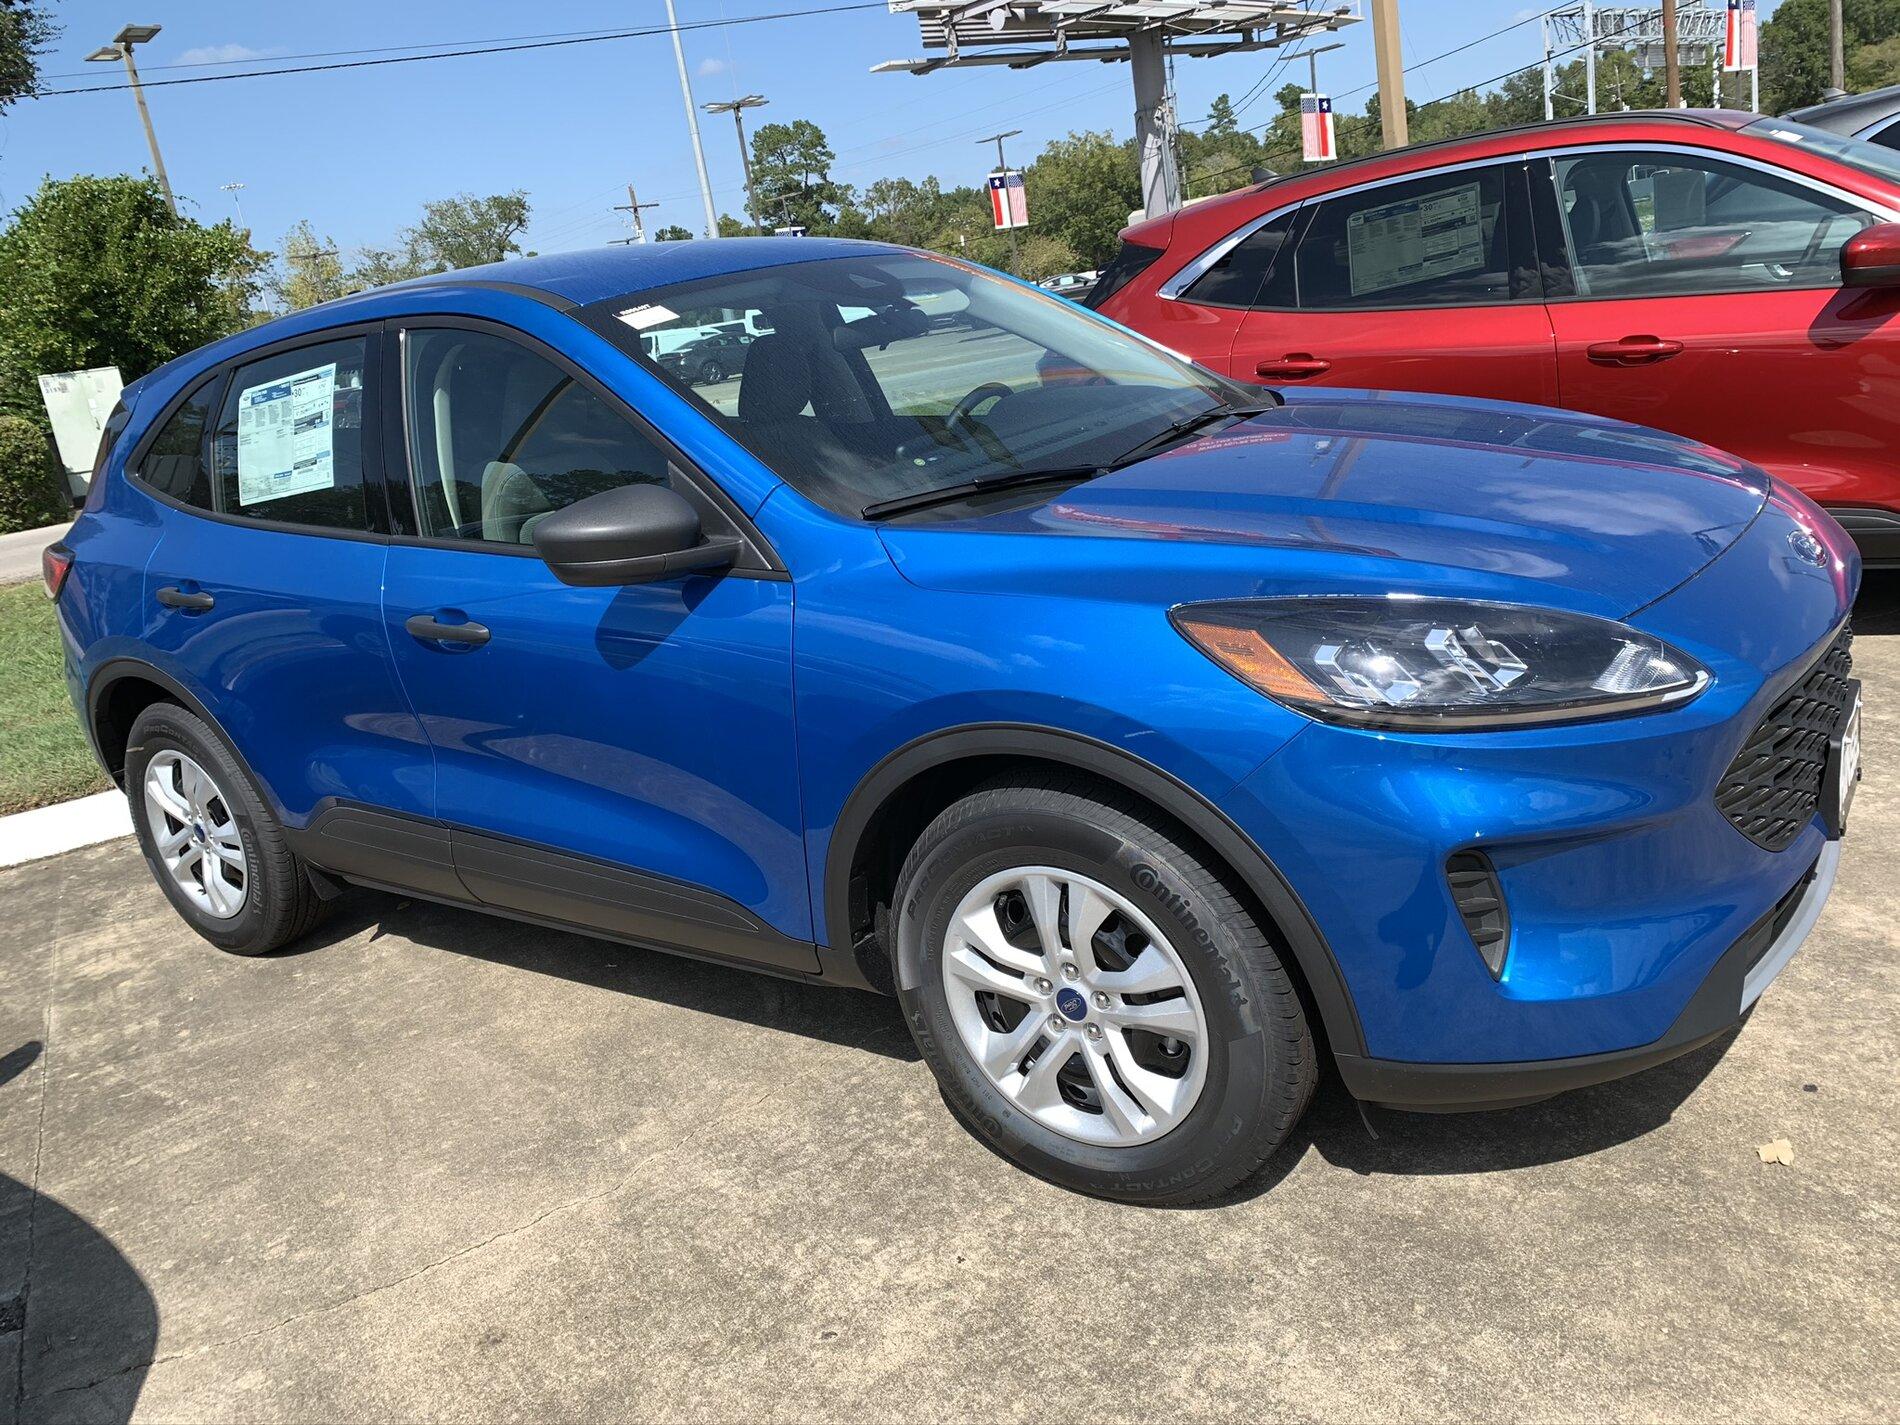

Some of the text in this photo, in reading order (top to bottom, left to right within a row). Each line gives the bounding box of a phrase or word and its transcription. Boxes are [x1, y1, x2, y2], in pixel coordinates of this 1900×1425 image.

[293, 388, 302, 398] 30
[242, 827, 263, 908] Continental
[1130, 863, 1242, 990] Continental
